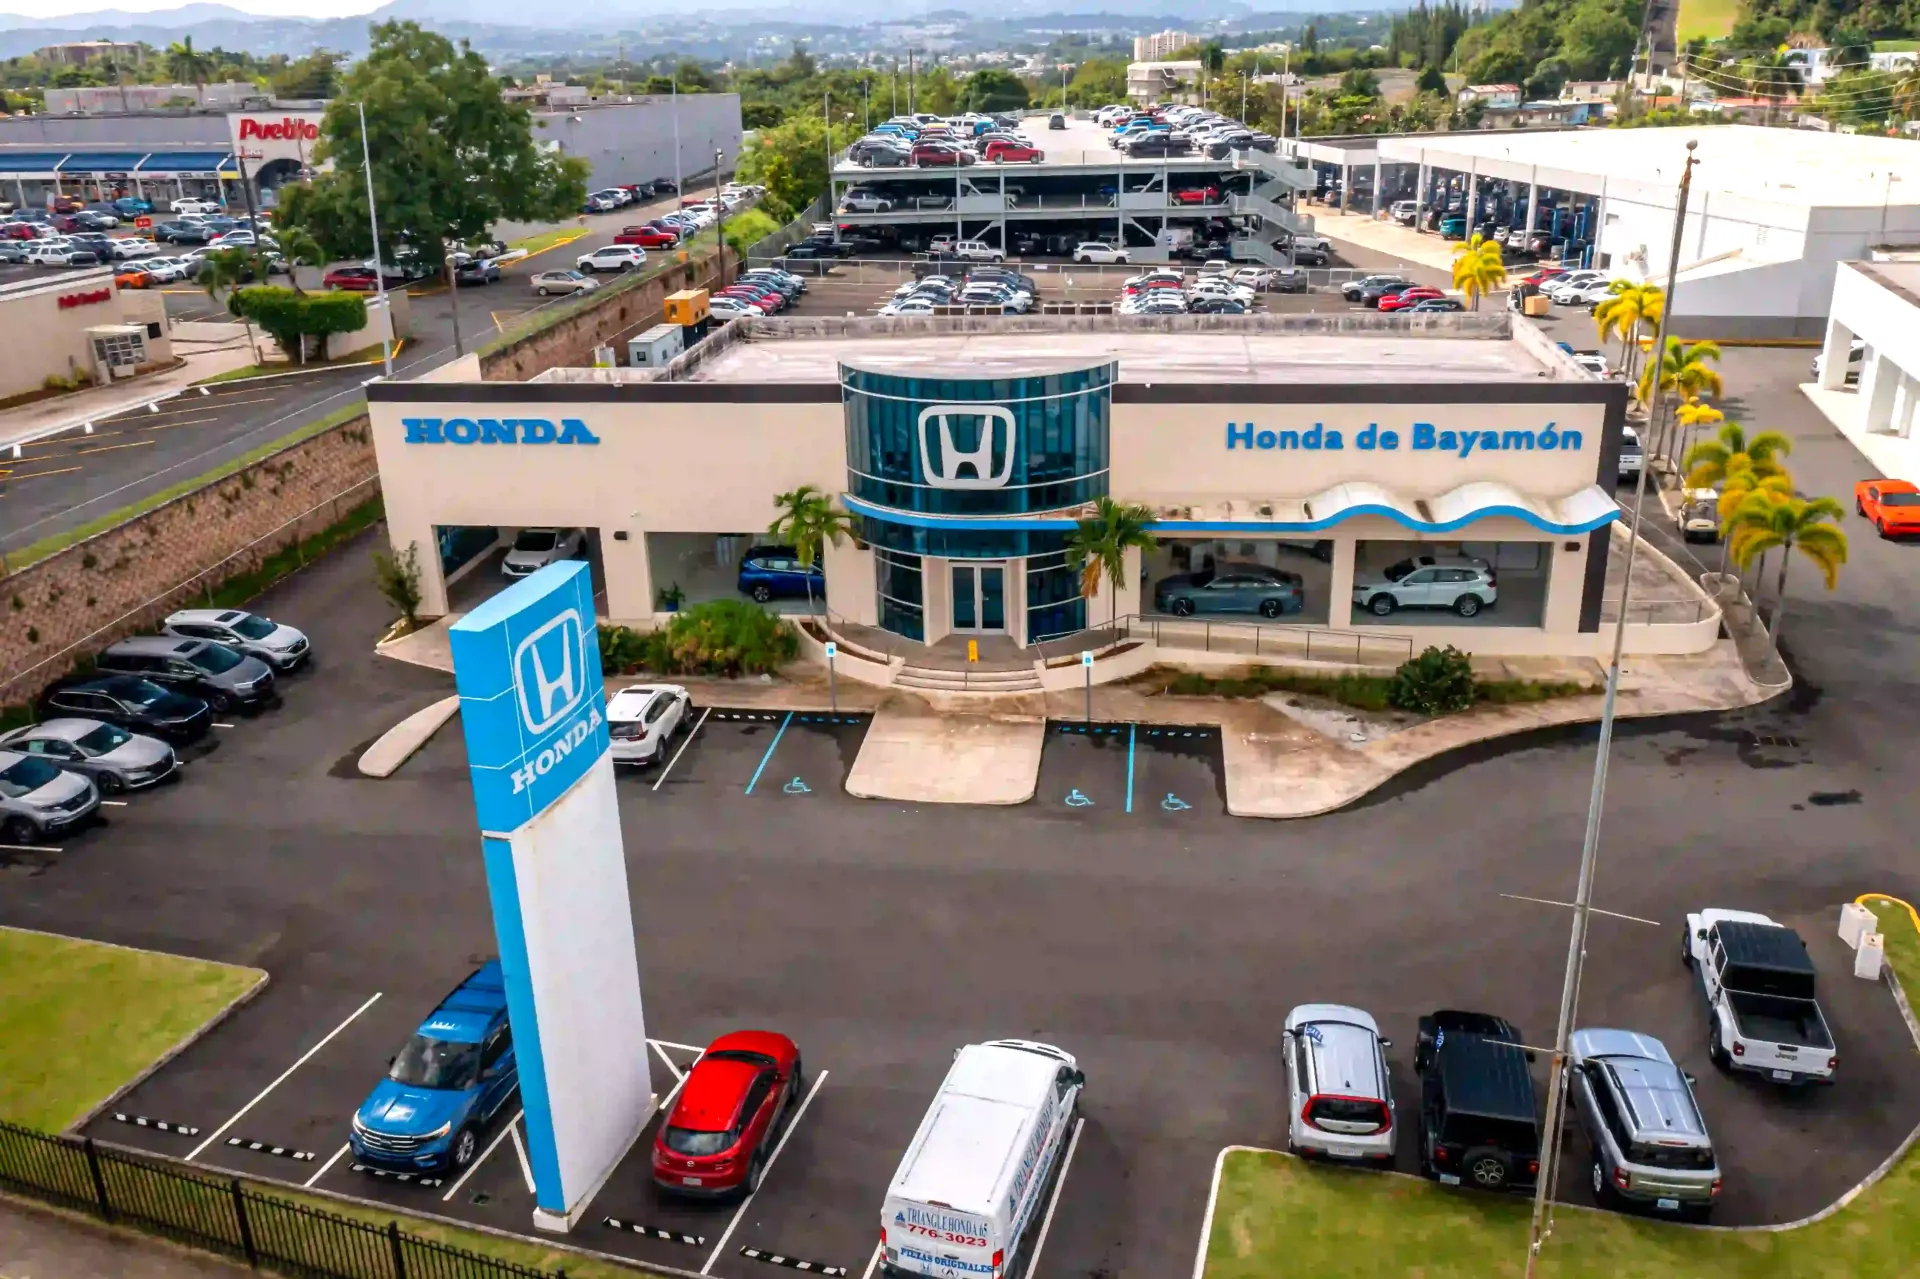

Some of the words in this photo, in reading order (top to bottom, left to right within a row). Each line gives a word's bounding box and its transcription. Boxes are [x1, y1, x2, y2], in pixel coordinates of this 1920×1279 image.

[240, 117, 318, 140] Pueblo
[402, 418, 601, 445] HONDA
[1226, 422, 1344, 450] Honda
[1356, 423, 1399, 450] de
[1412, 422, 1583, 459] Bayamón
[510, 707, 603, 795] HONDA
[907, 1223, 987, 1247] 776-3023
[934, 1256, 994, 1273] ORIGINALES
